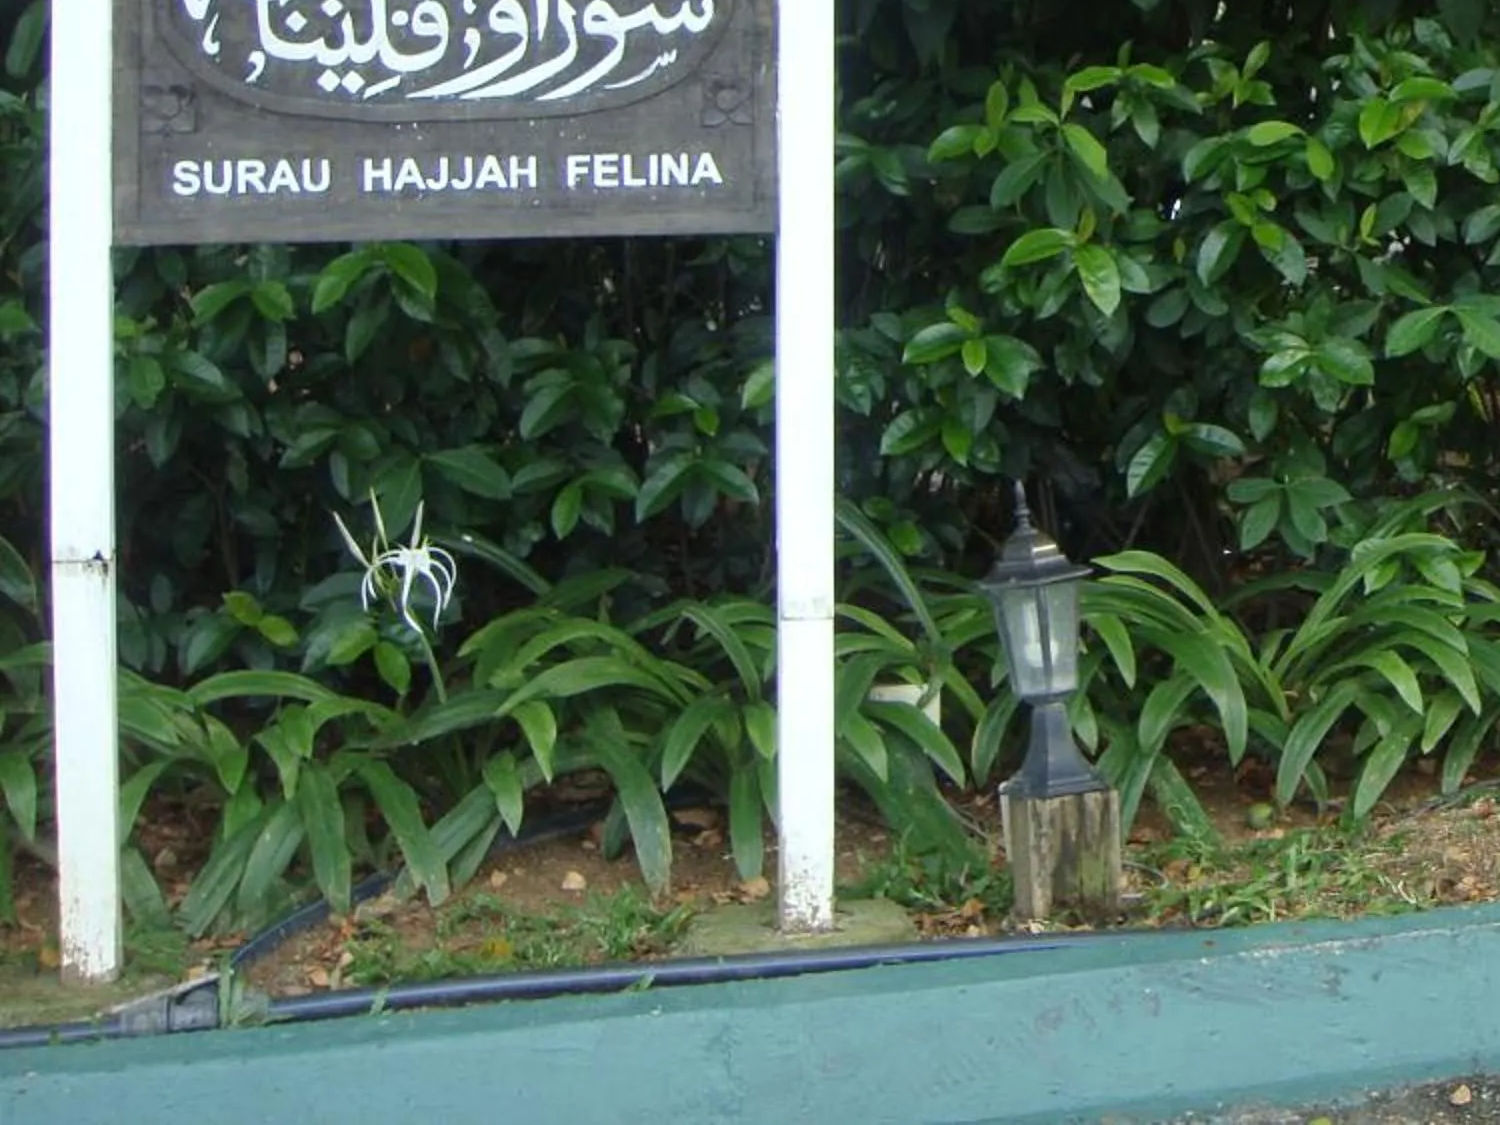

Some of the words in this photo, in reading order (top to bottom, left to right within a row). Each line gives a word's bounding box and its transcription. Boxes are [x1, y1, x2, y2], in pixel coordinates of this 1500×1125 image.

[172, 159, 331, 196] SURAU
[363, 156, 538, 192] HAJJAH
[566, 152, 724, 188] FELINA
